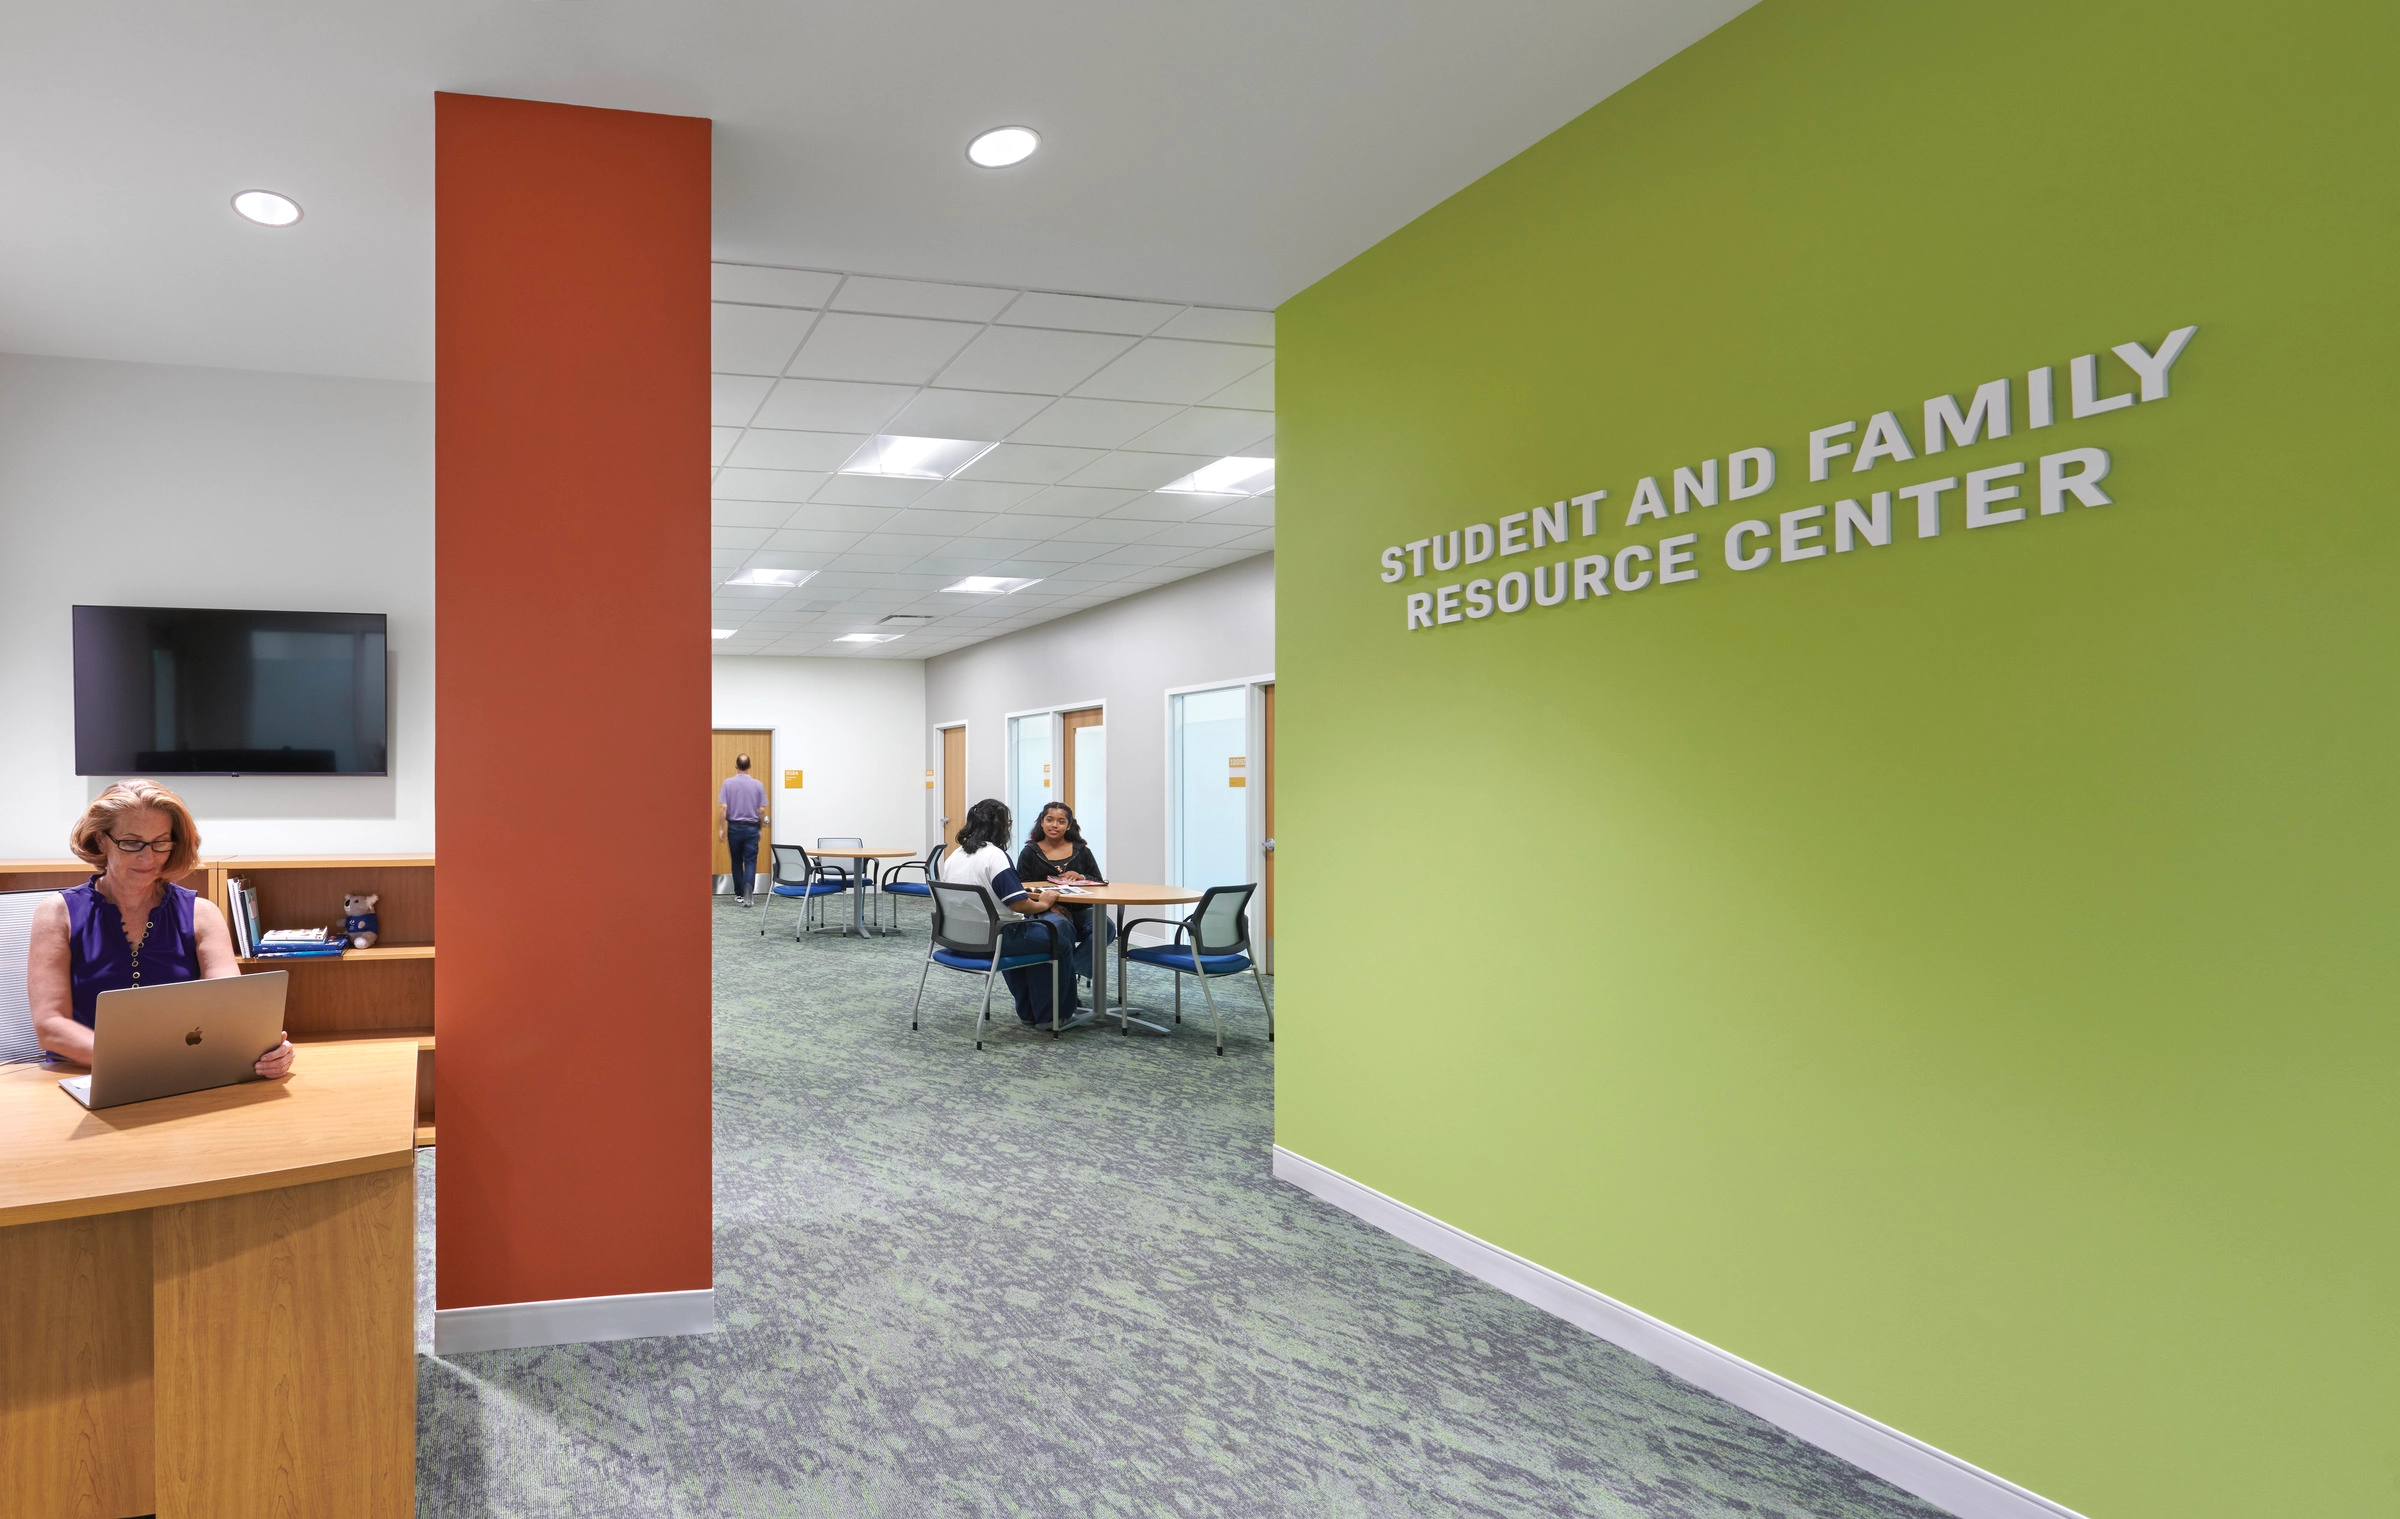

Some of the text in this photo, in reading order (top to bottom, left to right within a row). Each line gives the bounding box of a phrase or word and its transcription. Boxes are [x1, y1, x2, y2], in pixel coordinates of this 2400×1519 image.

[1381, 326, 2200, 583] STUDENT AND FAMILY
[1407, 448, 2114, 630] RESOURCE CENTER
